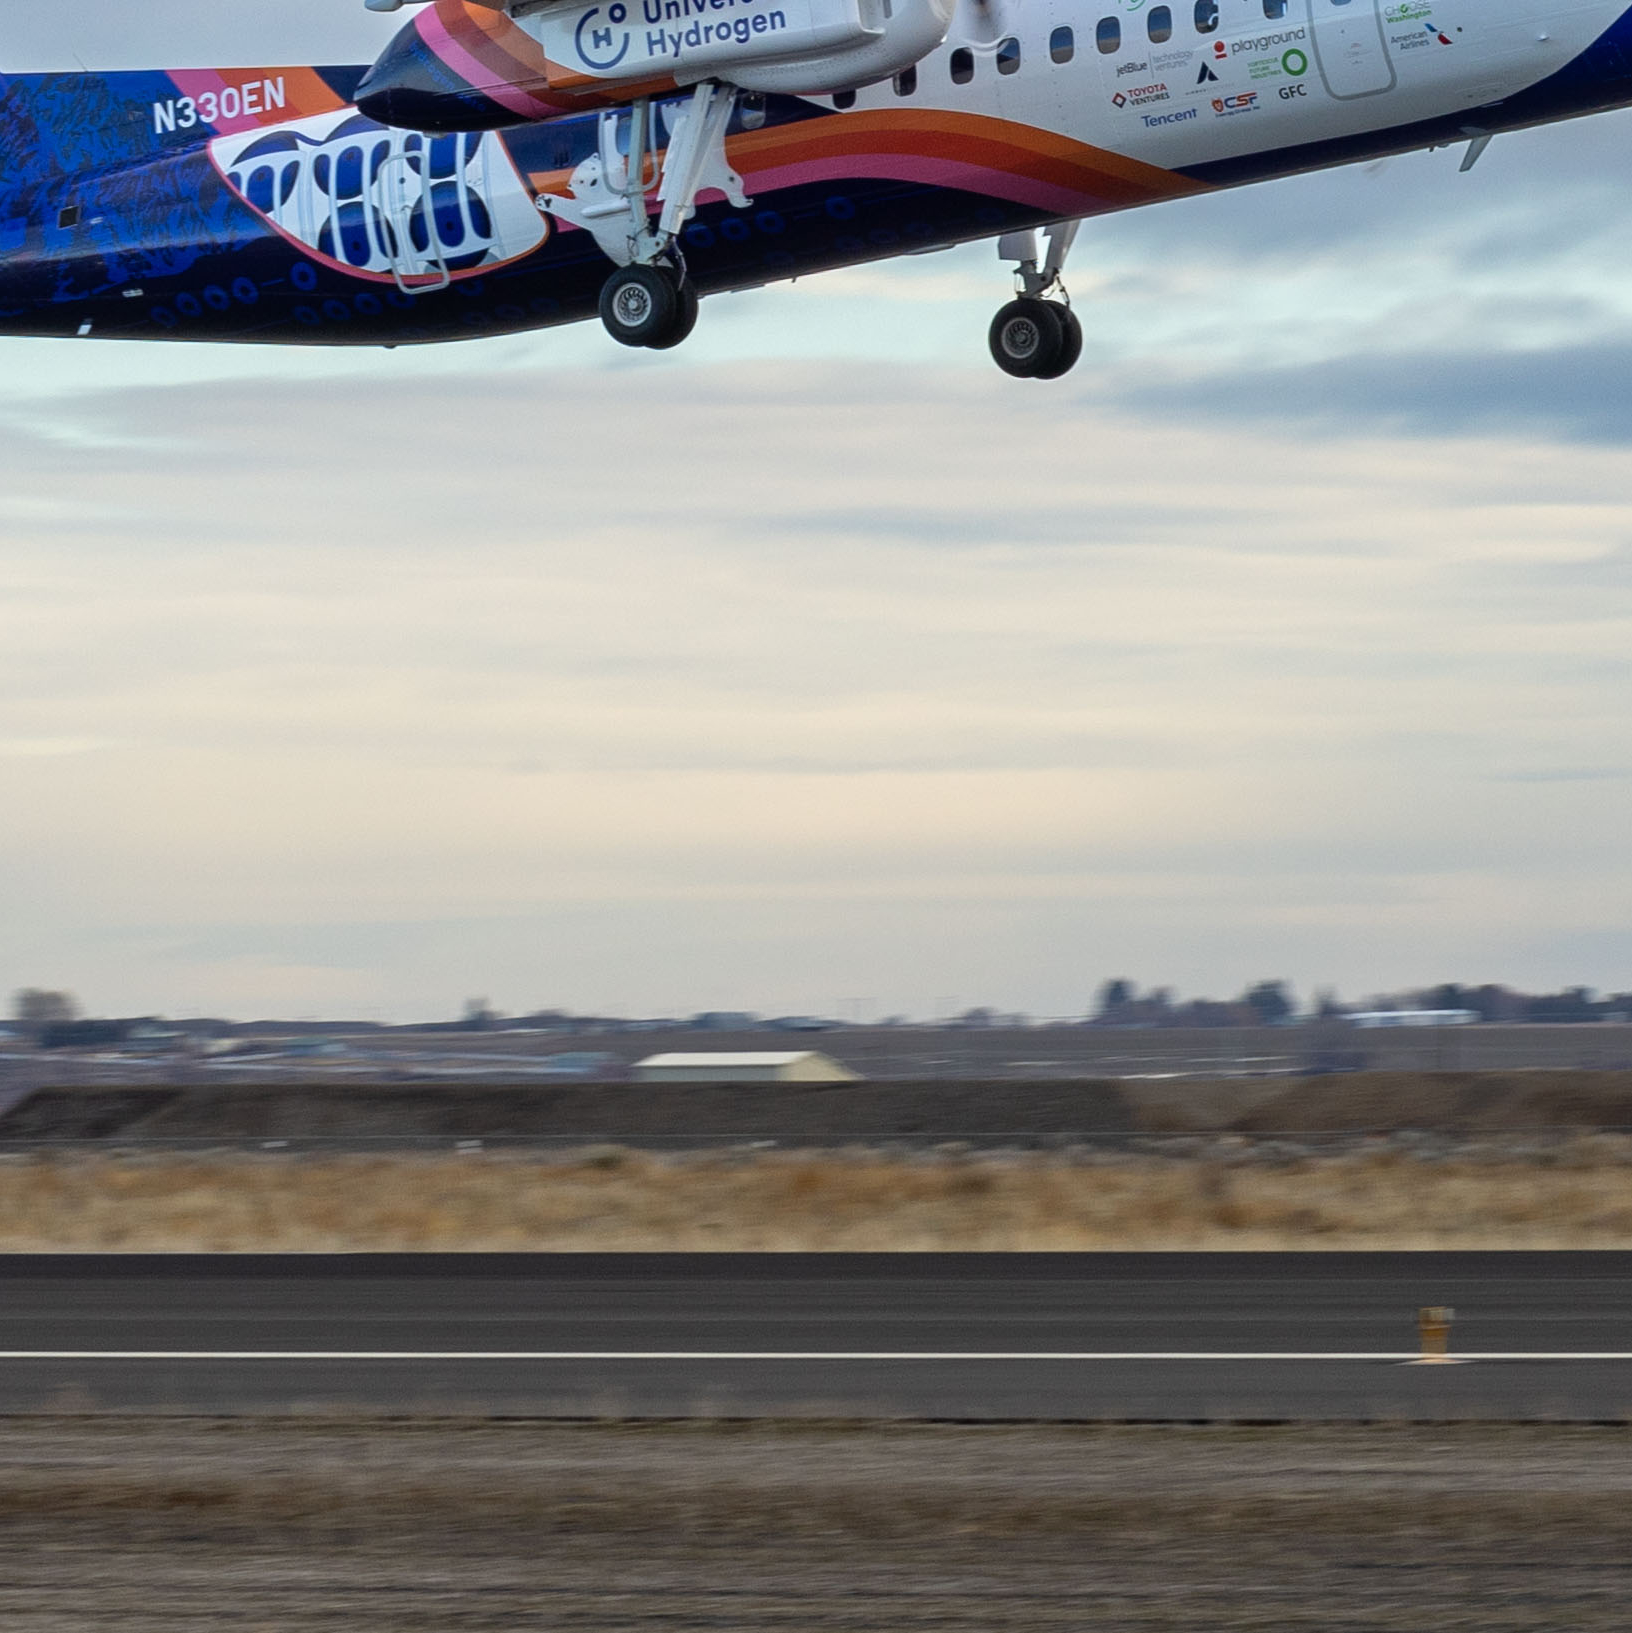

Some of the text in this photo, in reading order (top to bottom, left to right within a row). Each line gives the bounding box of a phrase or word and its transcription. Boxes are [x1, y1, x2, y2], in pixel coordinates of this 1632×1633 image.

[1385, 9, 1432, 24] Washington
[646, 9, 786, 58] Hydrogen
[1390, 30, 1428, 44] American
[1231, 28, 1306, 56] playground
[1400, 39, 1430, 51] Airlines
[1127, 83, 1168, 98] TOYOTA
[1278, 83, 1308, 100] GFC
[153, 76, 286, 135] N330EN
[1129, 93, 1170, 107] VENTURES
[1141, 108, 1198, 128] Tencent
